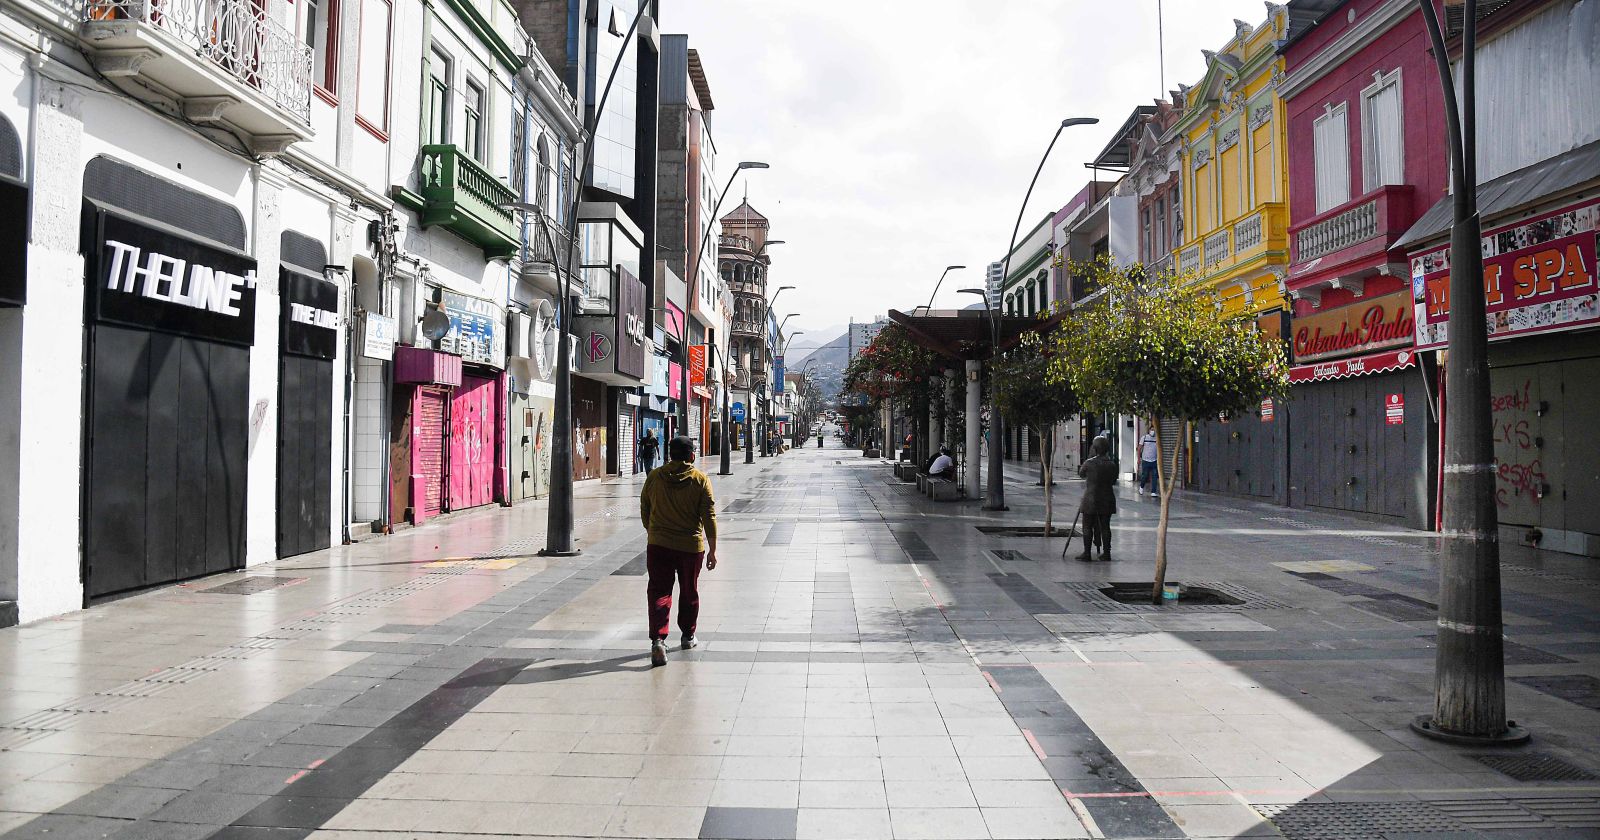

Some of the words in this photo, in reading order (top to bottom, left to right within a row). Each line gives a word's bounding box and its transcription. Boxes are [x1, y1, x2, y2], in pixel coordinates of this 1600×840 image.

[1513, 243, 1593, 300] SPA
[291, 302, 315, 325] THE
[1294, 321, 1361, 357] Calzados
[1361, 305, 1413, 345] Paola
[690, 346, 704, 377] Hotel
[1313, 363, 1340, 377] Calzados
[1345, 358, 1365, 373] Paola
